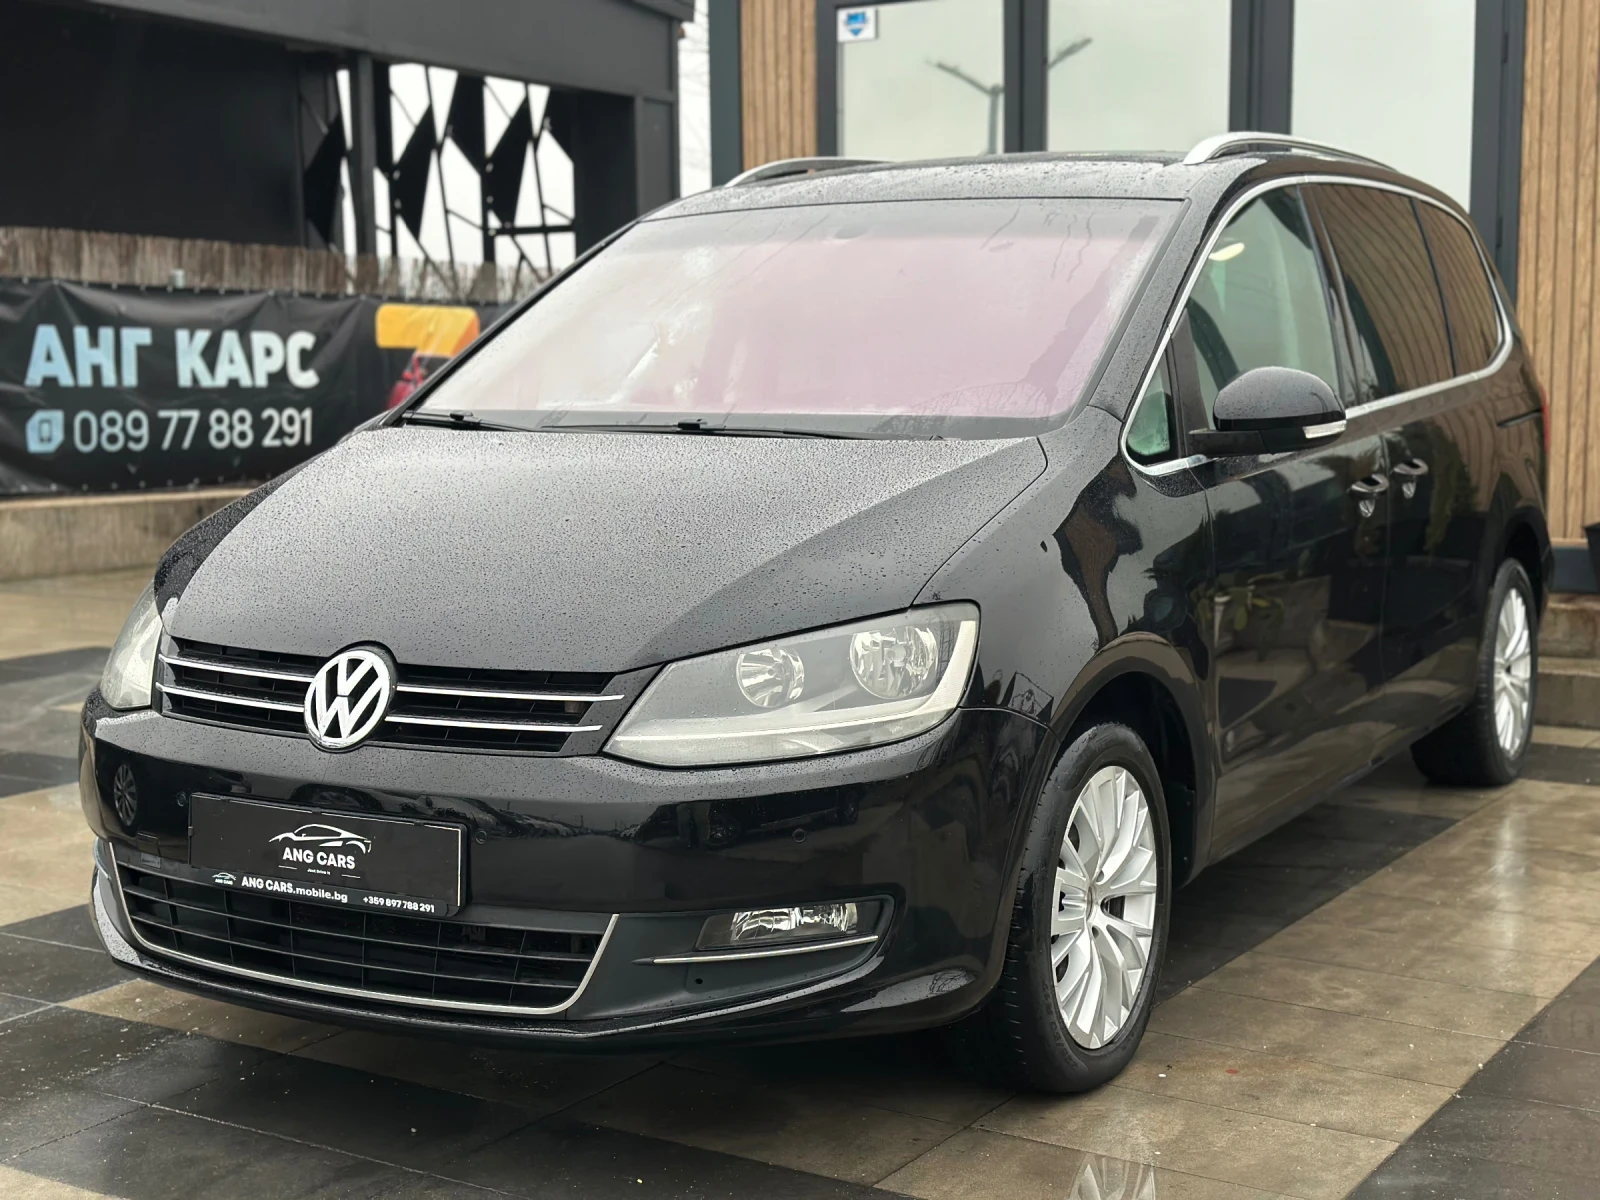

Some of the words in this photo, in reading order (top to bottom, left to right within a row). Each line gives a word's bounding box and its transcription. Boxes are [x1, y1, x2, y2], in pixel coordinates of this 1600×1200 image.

[24, 324, 152, 388] АНГ
[175, 328, 320, 388] КАРС
[73, 410, 151, 453] 089
[158, 410, 201, 450] 77
[208, 408, 254, 449] 88
[260, 407, 313, 447] 291
[282, 846, 314, 864] ANG
[316, 851, 356, 870] CARS
[241, 876, 264, 890] ANG
[363, 896, 384, 906] +359
[385, 898, 402, 908] 897
[402, 900, 418, 910] 788
[419, 902, 435, 913] 291
